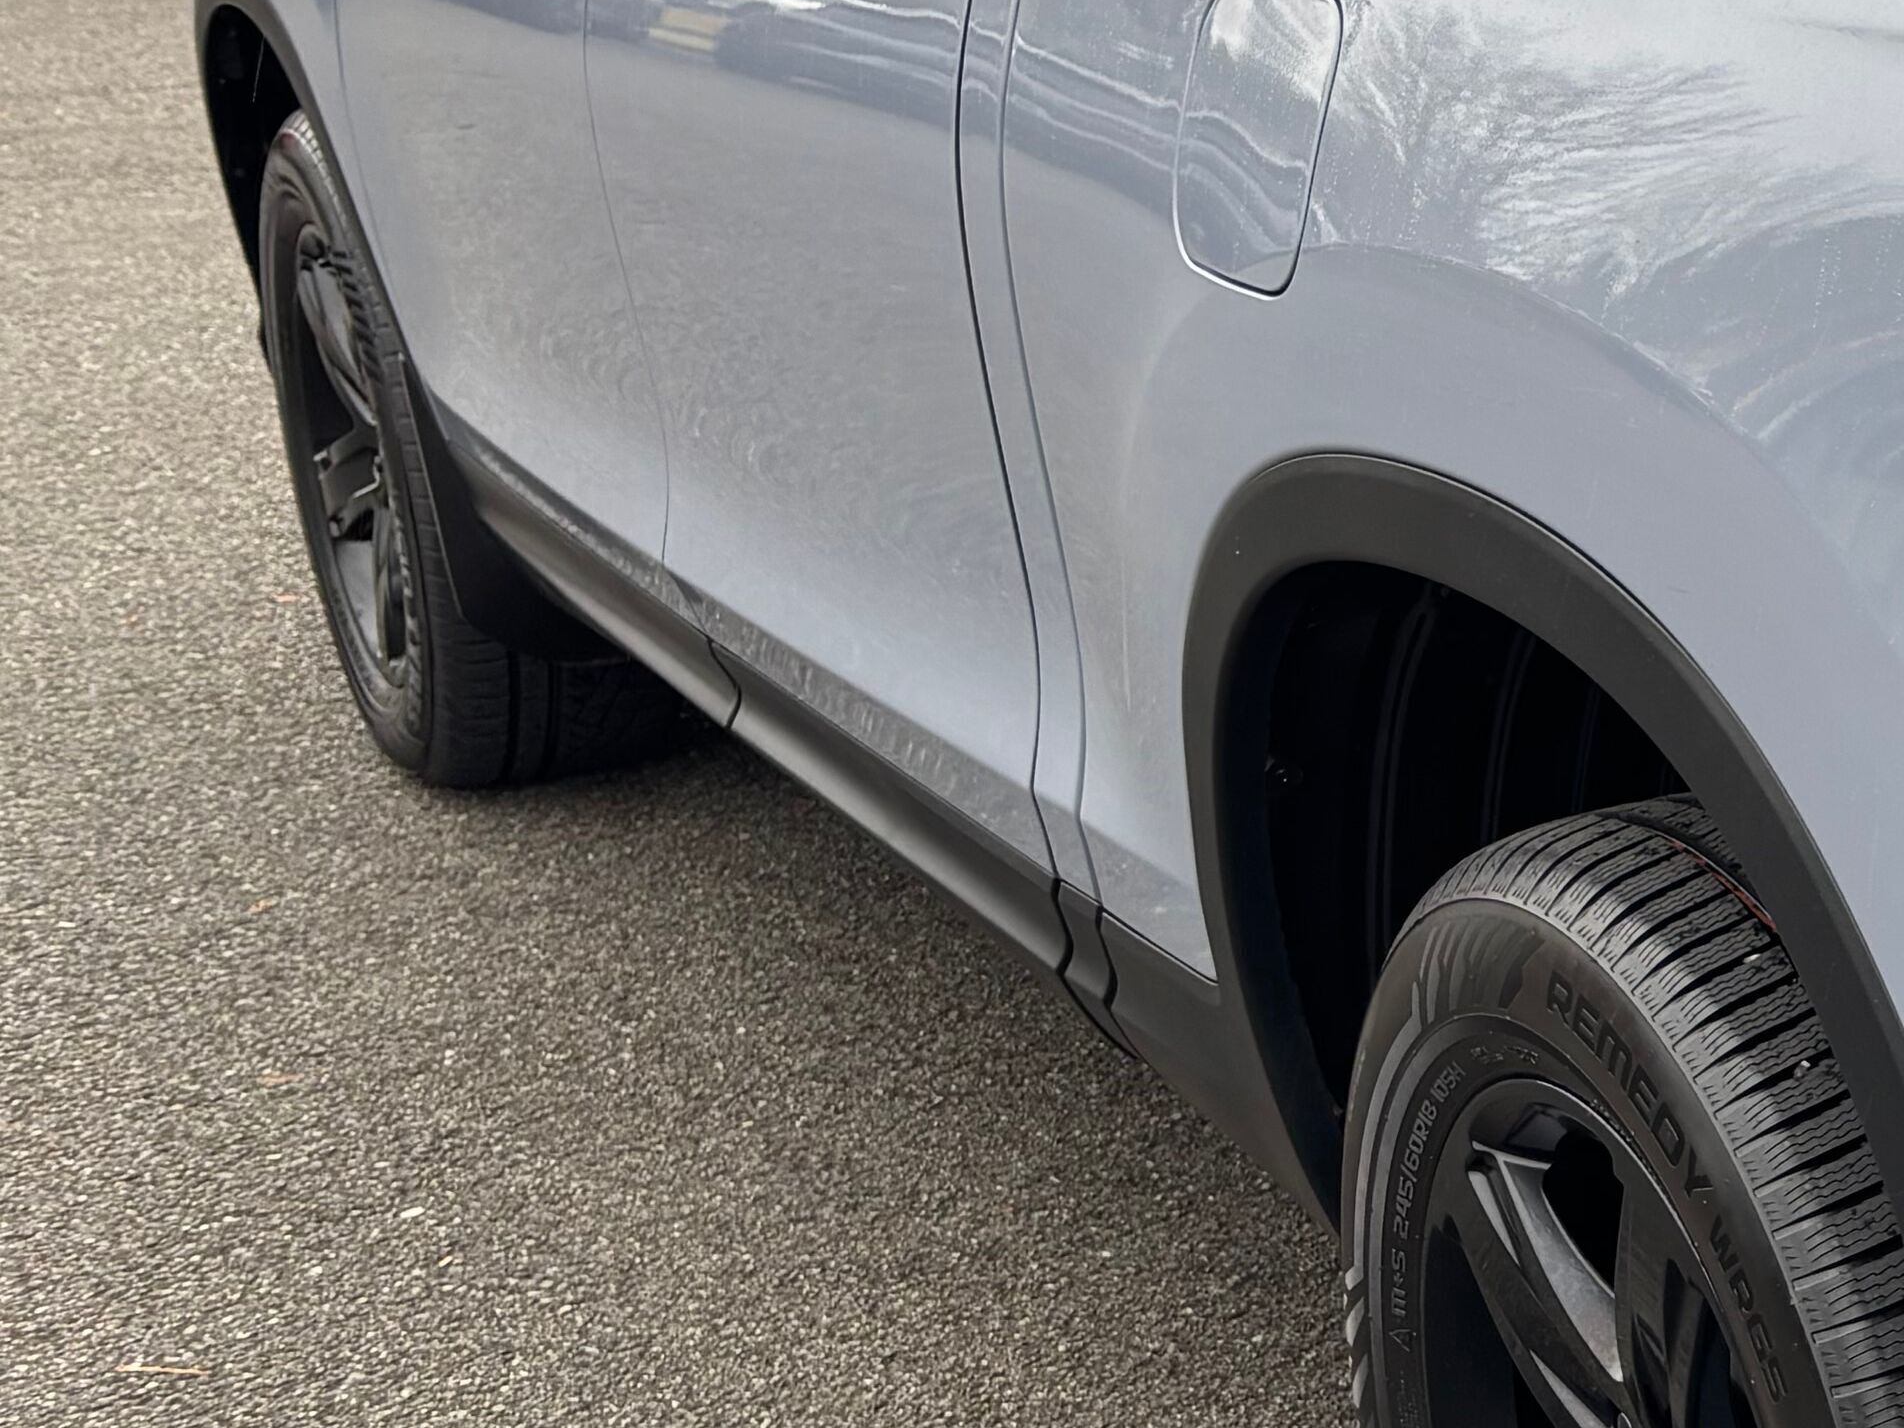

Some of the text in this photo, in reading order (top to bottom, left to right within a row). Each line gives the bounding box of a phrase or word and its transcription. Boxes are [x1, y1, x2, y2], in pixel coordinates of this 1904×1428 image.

[1390, 1060, 1466, 1317] M+S 245/60R18 105H
[1547, 971, 1713, 1199] REMEDY
